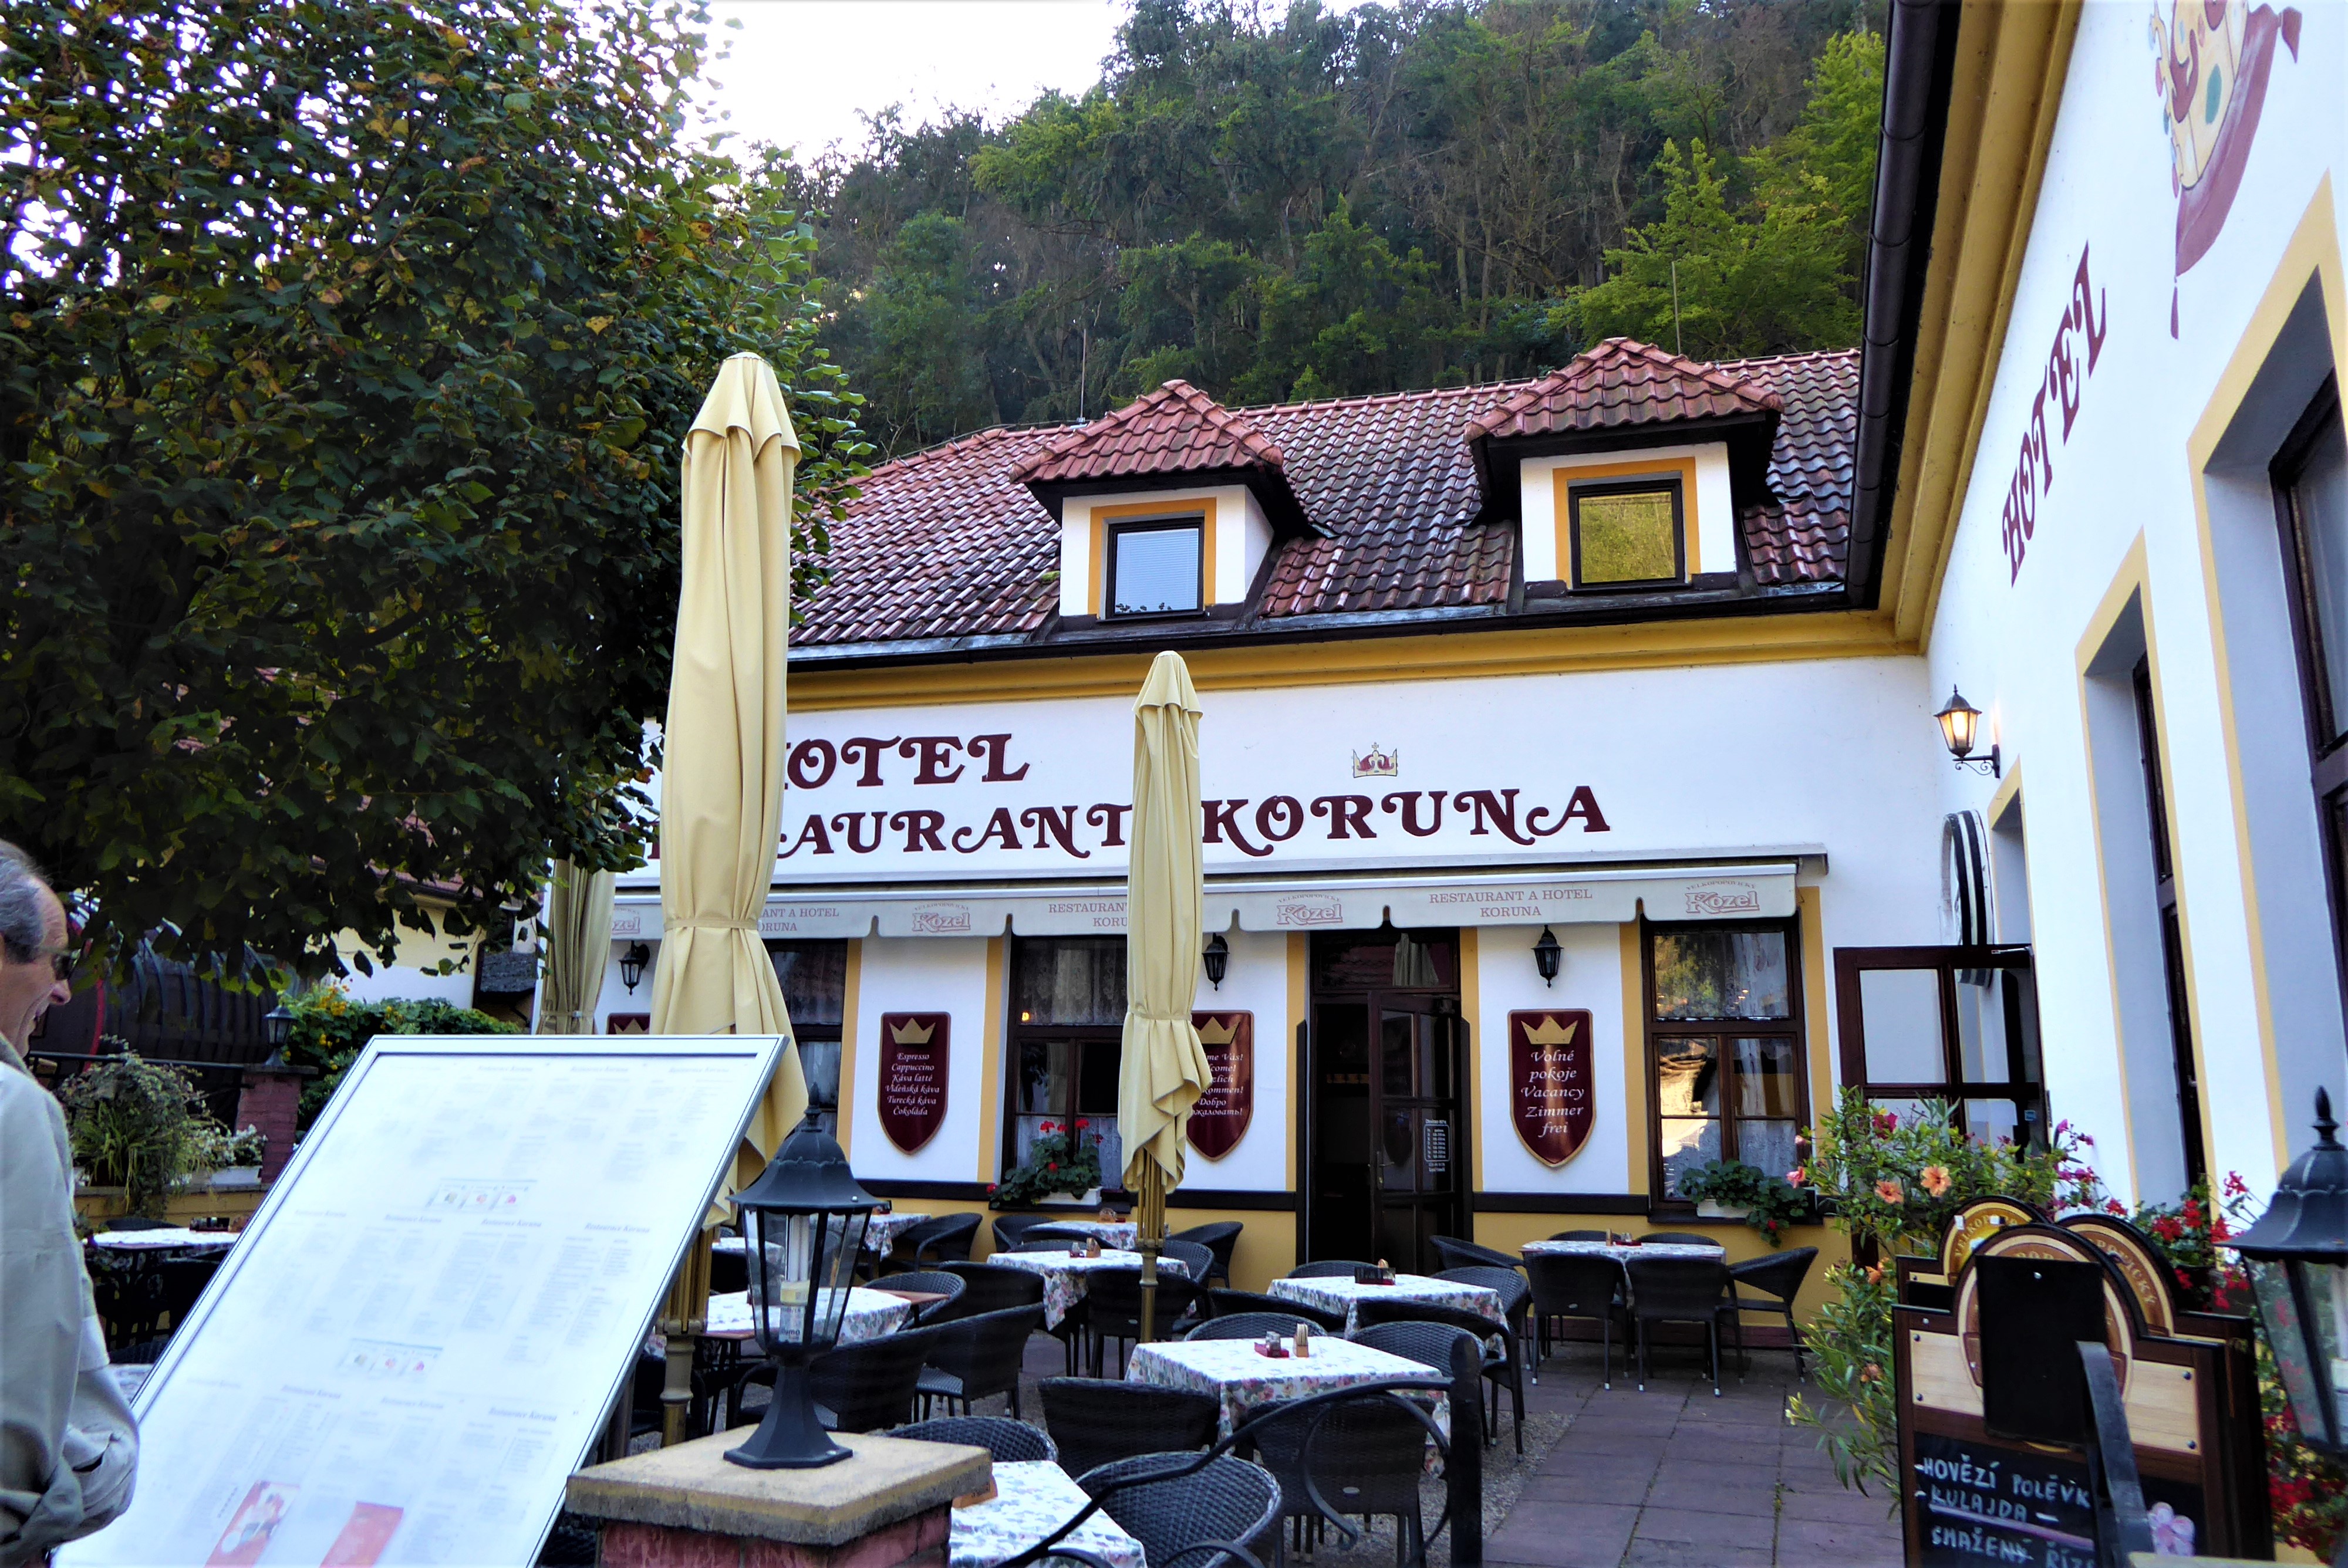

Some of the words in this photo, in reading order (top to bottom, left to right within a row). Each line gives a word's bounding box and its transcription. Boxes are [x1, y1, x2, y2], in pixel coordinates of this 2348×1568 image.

[2002, 239, 2106, 589] HOTEL
[785, 733, 1031, 790] OTEL
[1201, 785, 1611, 857] KORUNA
[1429, 891, 1524, 904] RESTAURANT
[1528, 890, 1538, 900] A
[1541, 888, 1593, 900] HOTEL
[1685, 891, 1760, 914] Kozel
[799, 907, 840, 917] HOTEL
[1276, 904, 1343, 926] Kozel
[1479, 906, 1542, 918] KORUNA
[912, 912, 971, 933] Kozel
[1092, 917, 1128, 927] KORU
[896, 1052, 930, 1063] Espresso
[1530, 1049, 1575, 1063] Volné
[891, 1063, 935, 1073] Cappuccino
[1529, 1066, 1578, 1083] pokoje
[1520, 1085, 1585, 1101] Vacancy
[1524, 1105, 1585, 1117] Zimmer
[1537, 1121, 1569, 1138] frei
[1931, 1484, 2028, 1523] KULAJDA
